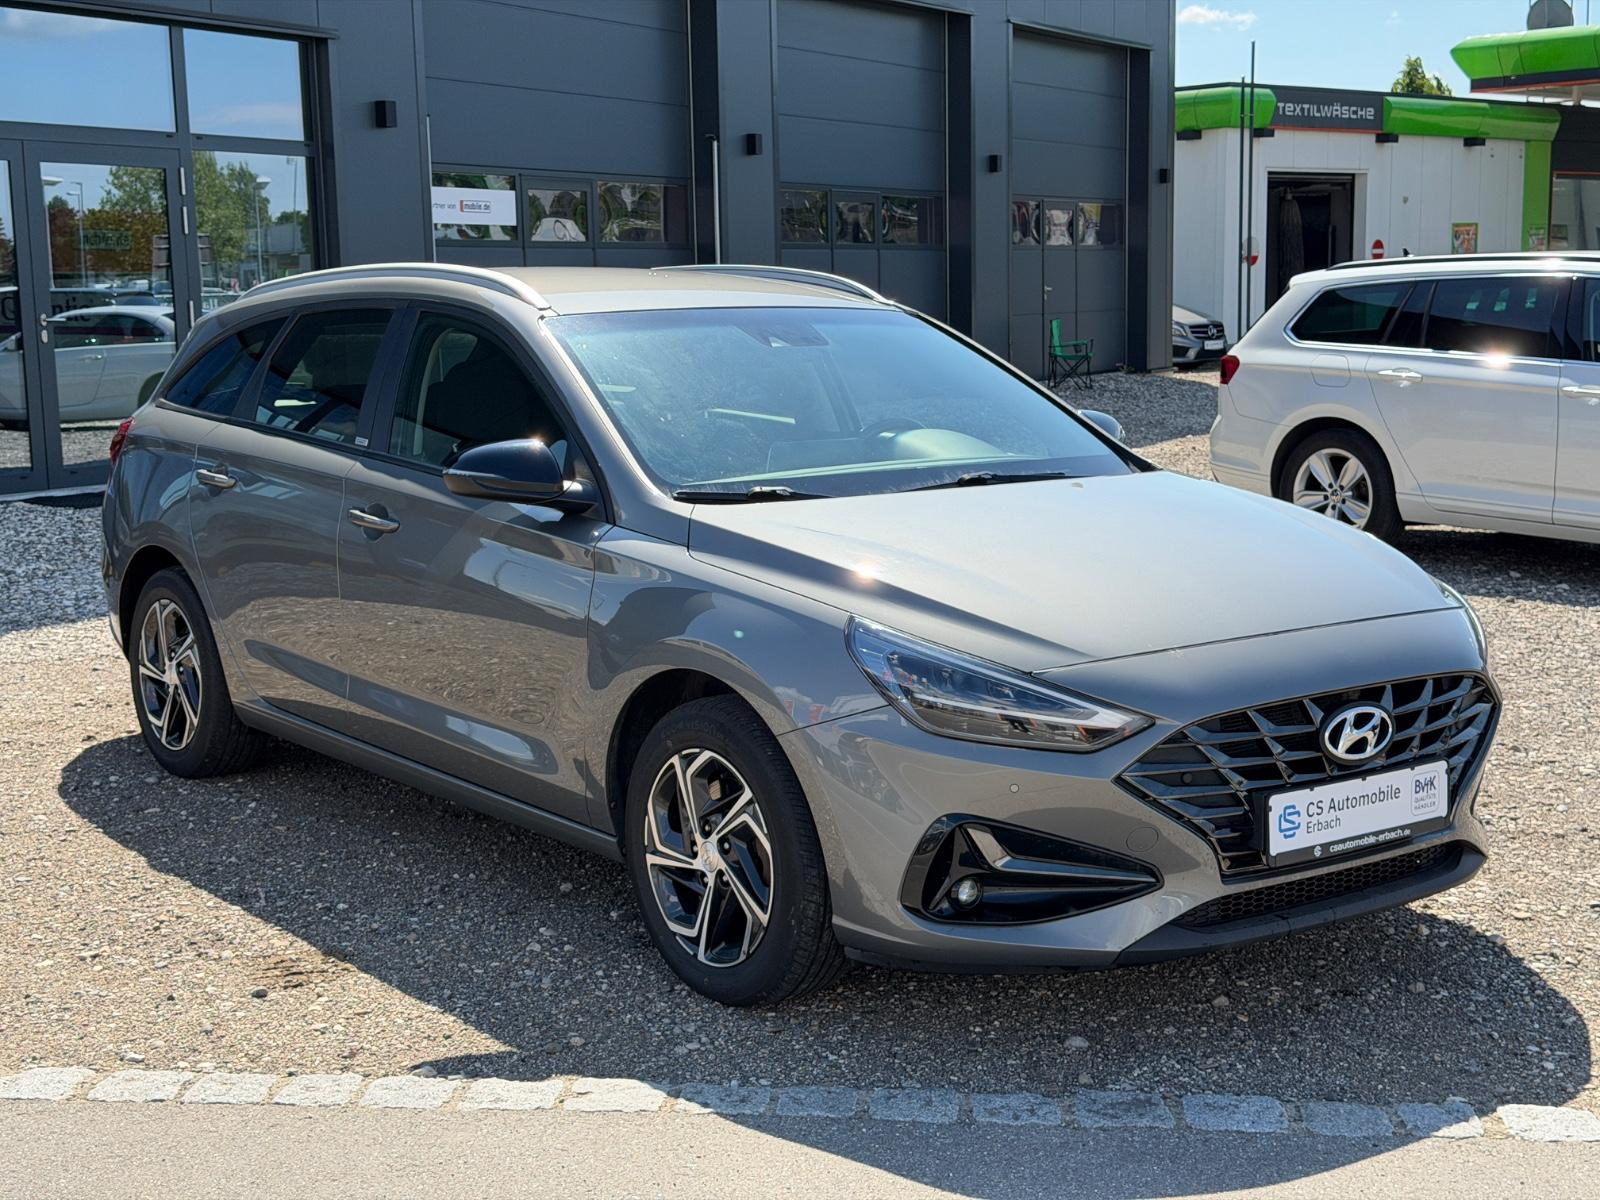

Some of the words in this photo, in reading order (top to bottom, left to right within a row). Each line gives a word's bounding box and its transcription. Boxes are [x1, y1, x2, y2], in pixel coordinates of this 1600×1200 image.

[1306, 800, 1324, 818] CS
[1327, 784, 1401, 814] Automobile
[1306, 815, 1341, 834] Erbach
[1329, 828, 1411, 853] csautomobile-erbach.de
